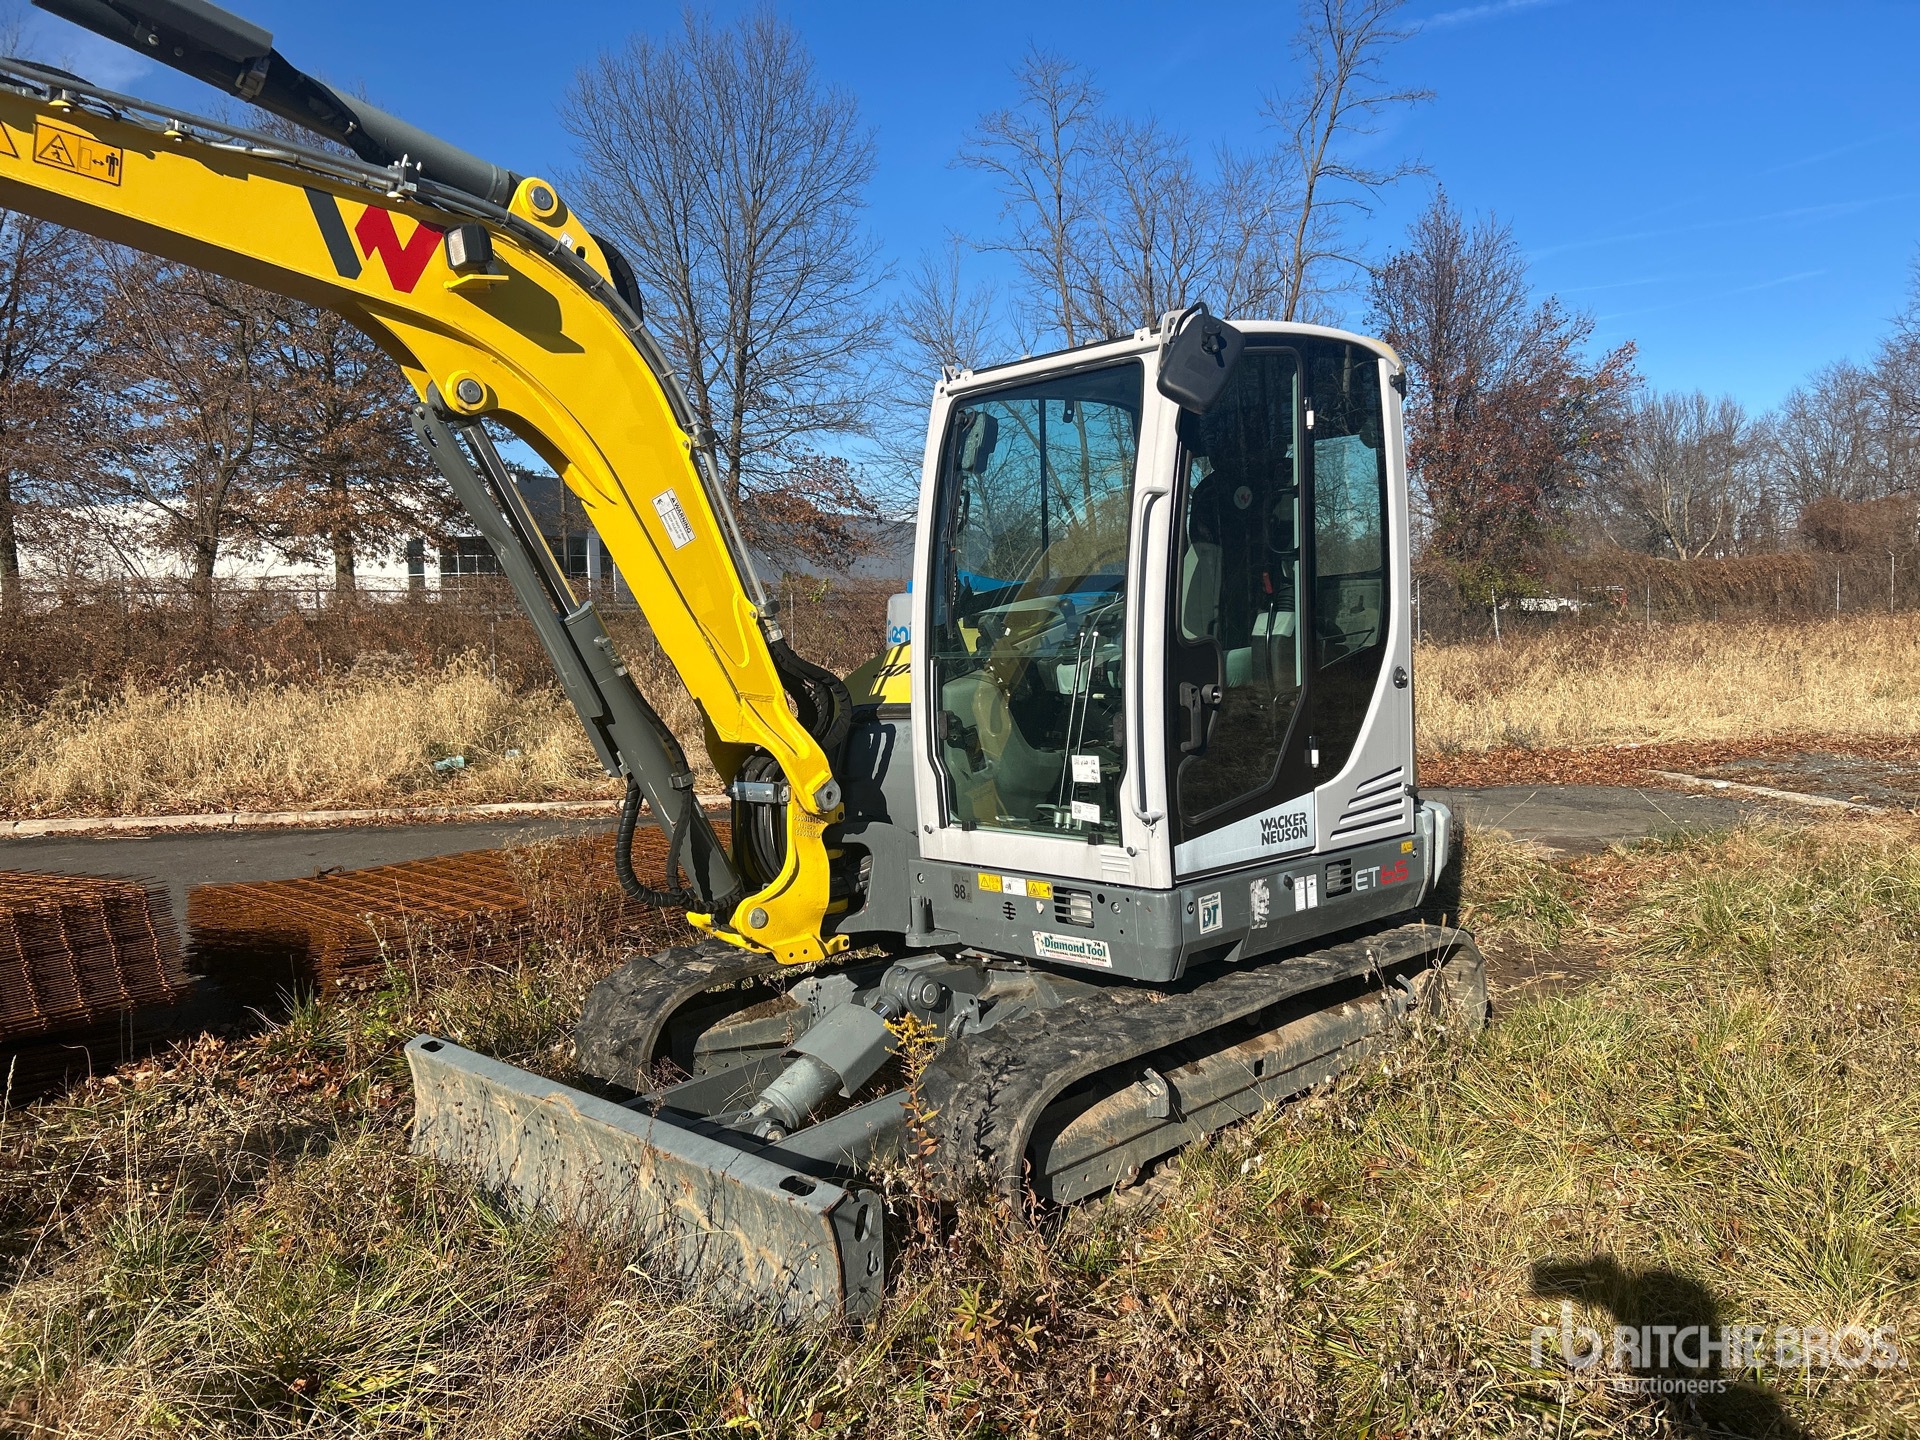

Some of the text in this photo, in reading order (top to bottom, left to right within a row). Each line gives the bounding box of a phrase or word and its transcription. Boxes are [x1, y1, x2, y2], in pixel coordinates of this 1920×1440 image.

[674, 502, 692, 533] WARNING
[1260, 812, 1307, 832] WACKER
[1262, 825, 1308, 846] NEUSON
[1355, 859, 1409, 891] ET65
[953, 884, 966, 900] 98
[1202, 904, 1219, 929] DT
[1044, 934, 1085, 954] Diamond
[1086, 943, 1106, 957] Tool
